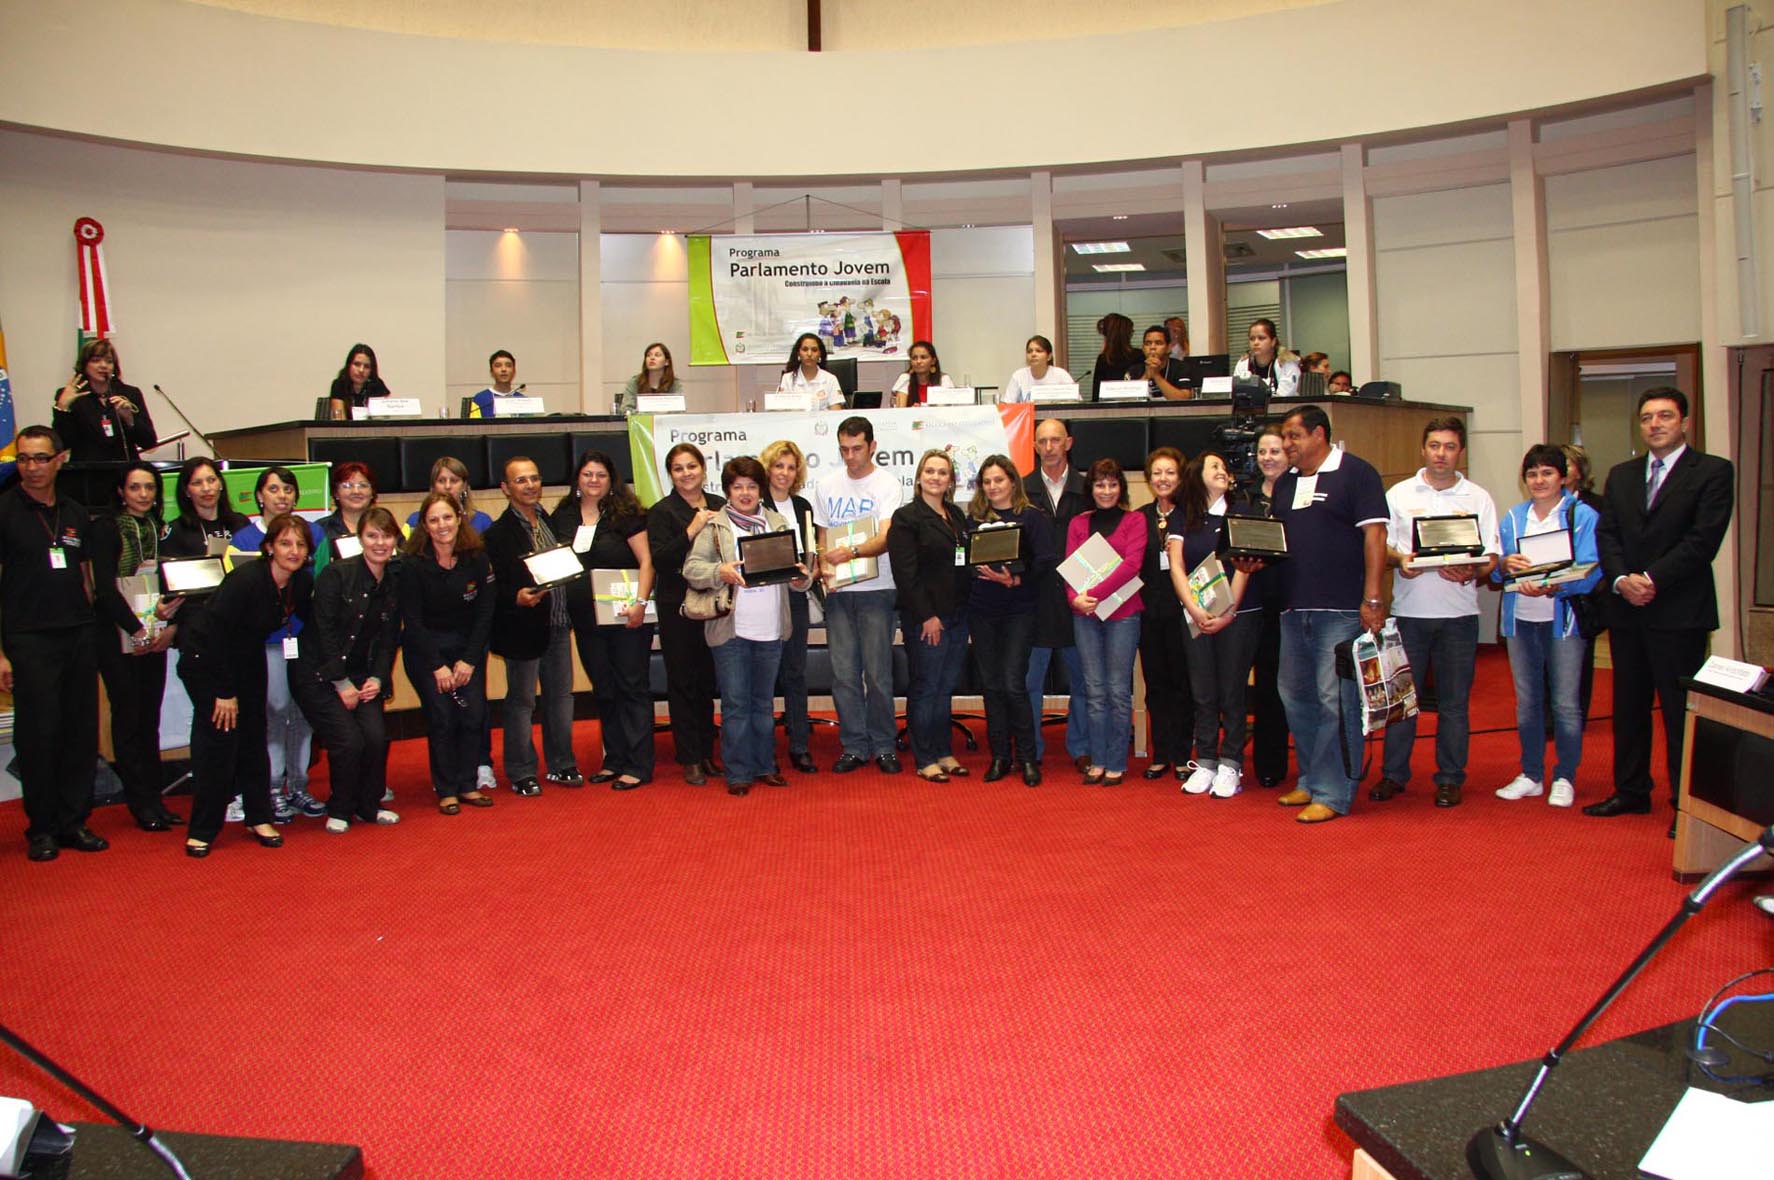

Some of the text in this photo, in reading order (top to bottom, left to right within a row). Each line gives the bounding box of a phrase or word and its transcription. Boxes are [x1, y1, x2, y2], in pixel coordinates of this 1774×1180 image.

[729, 248, 780, 259] Programa
[730, 261, 890, 277] Parlamento Jovem
[671, 429, 747, 445] Programa
